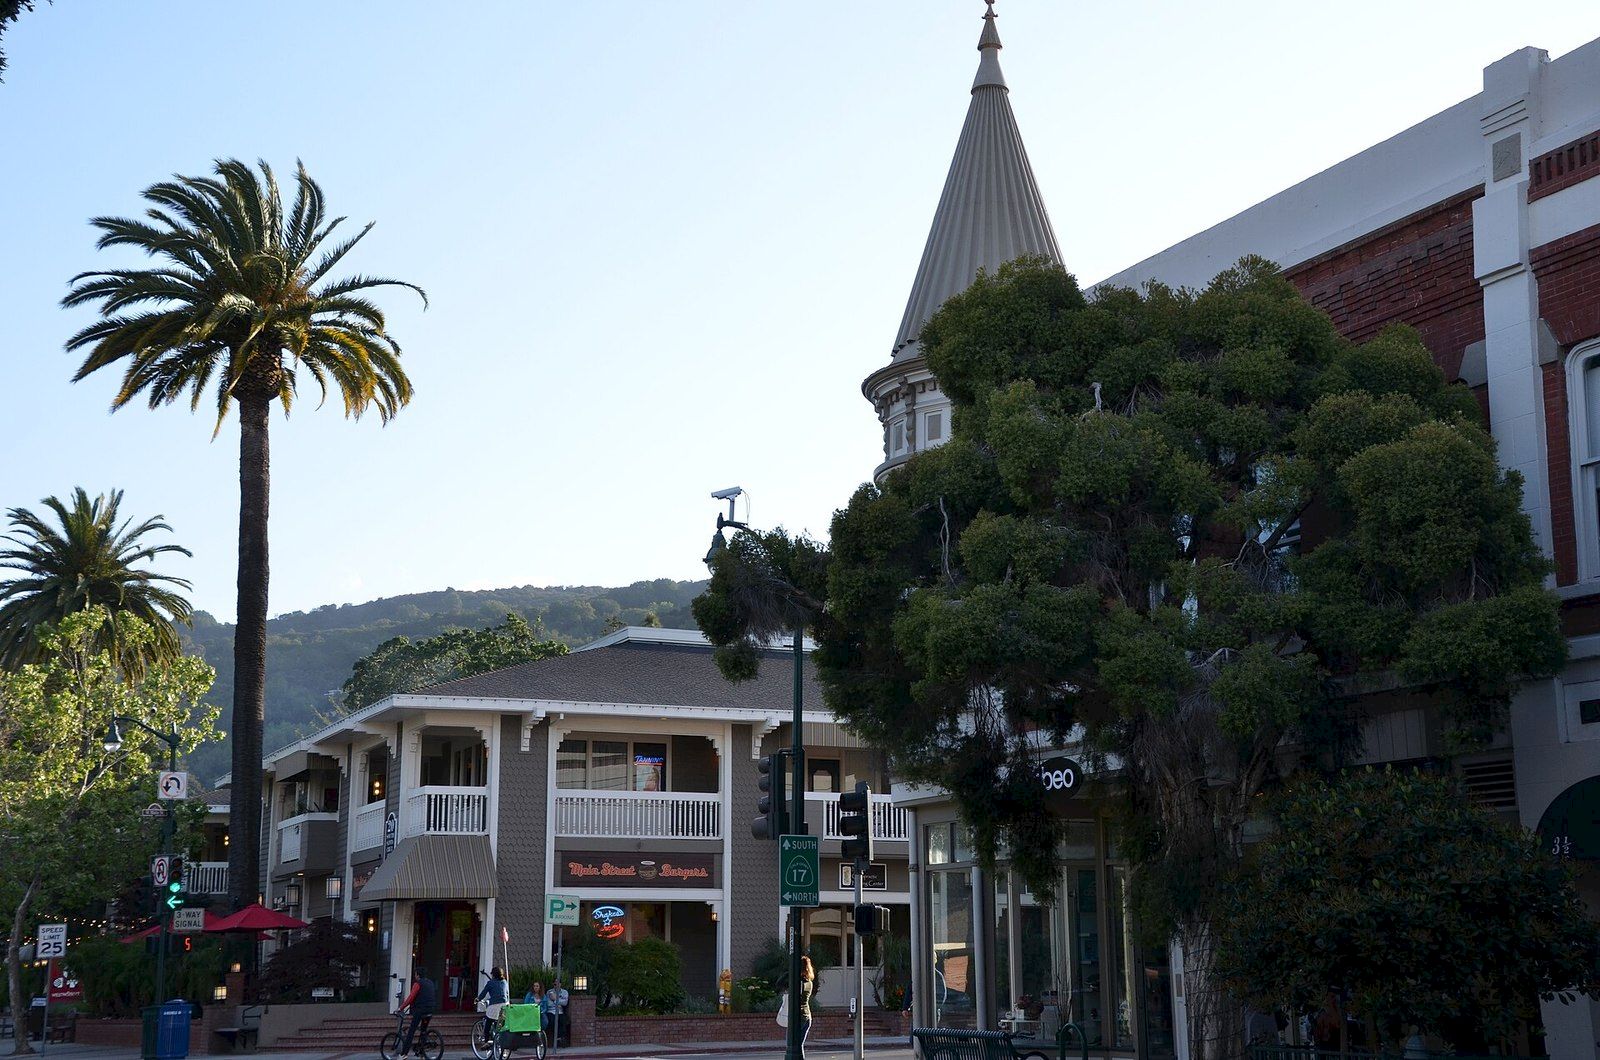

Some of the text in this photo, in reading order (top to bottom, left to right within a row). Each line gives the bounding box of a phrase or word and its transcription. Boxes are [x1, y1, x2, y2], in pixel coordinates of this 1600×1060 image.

[792, 840, 817, 849] SOUTH
[568, 862, 708, 880] Main Street Burgers
[793, 869, 807, 882] 17
[792, 893, 818, 902] NORTH
[176, 911, 202, 919] 3-WAY
[175, 920, 202, 928] SIGNAL
[41, 942, 62, 954] 25
